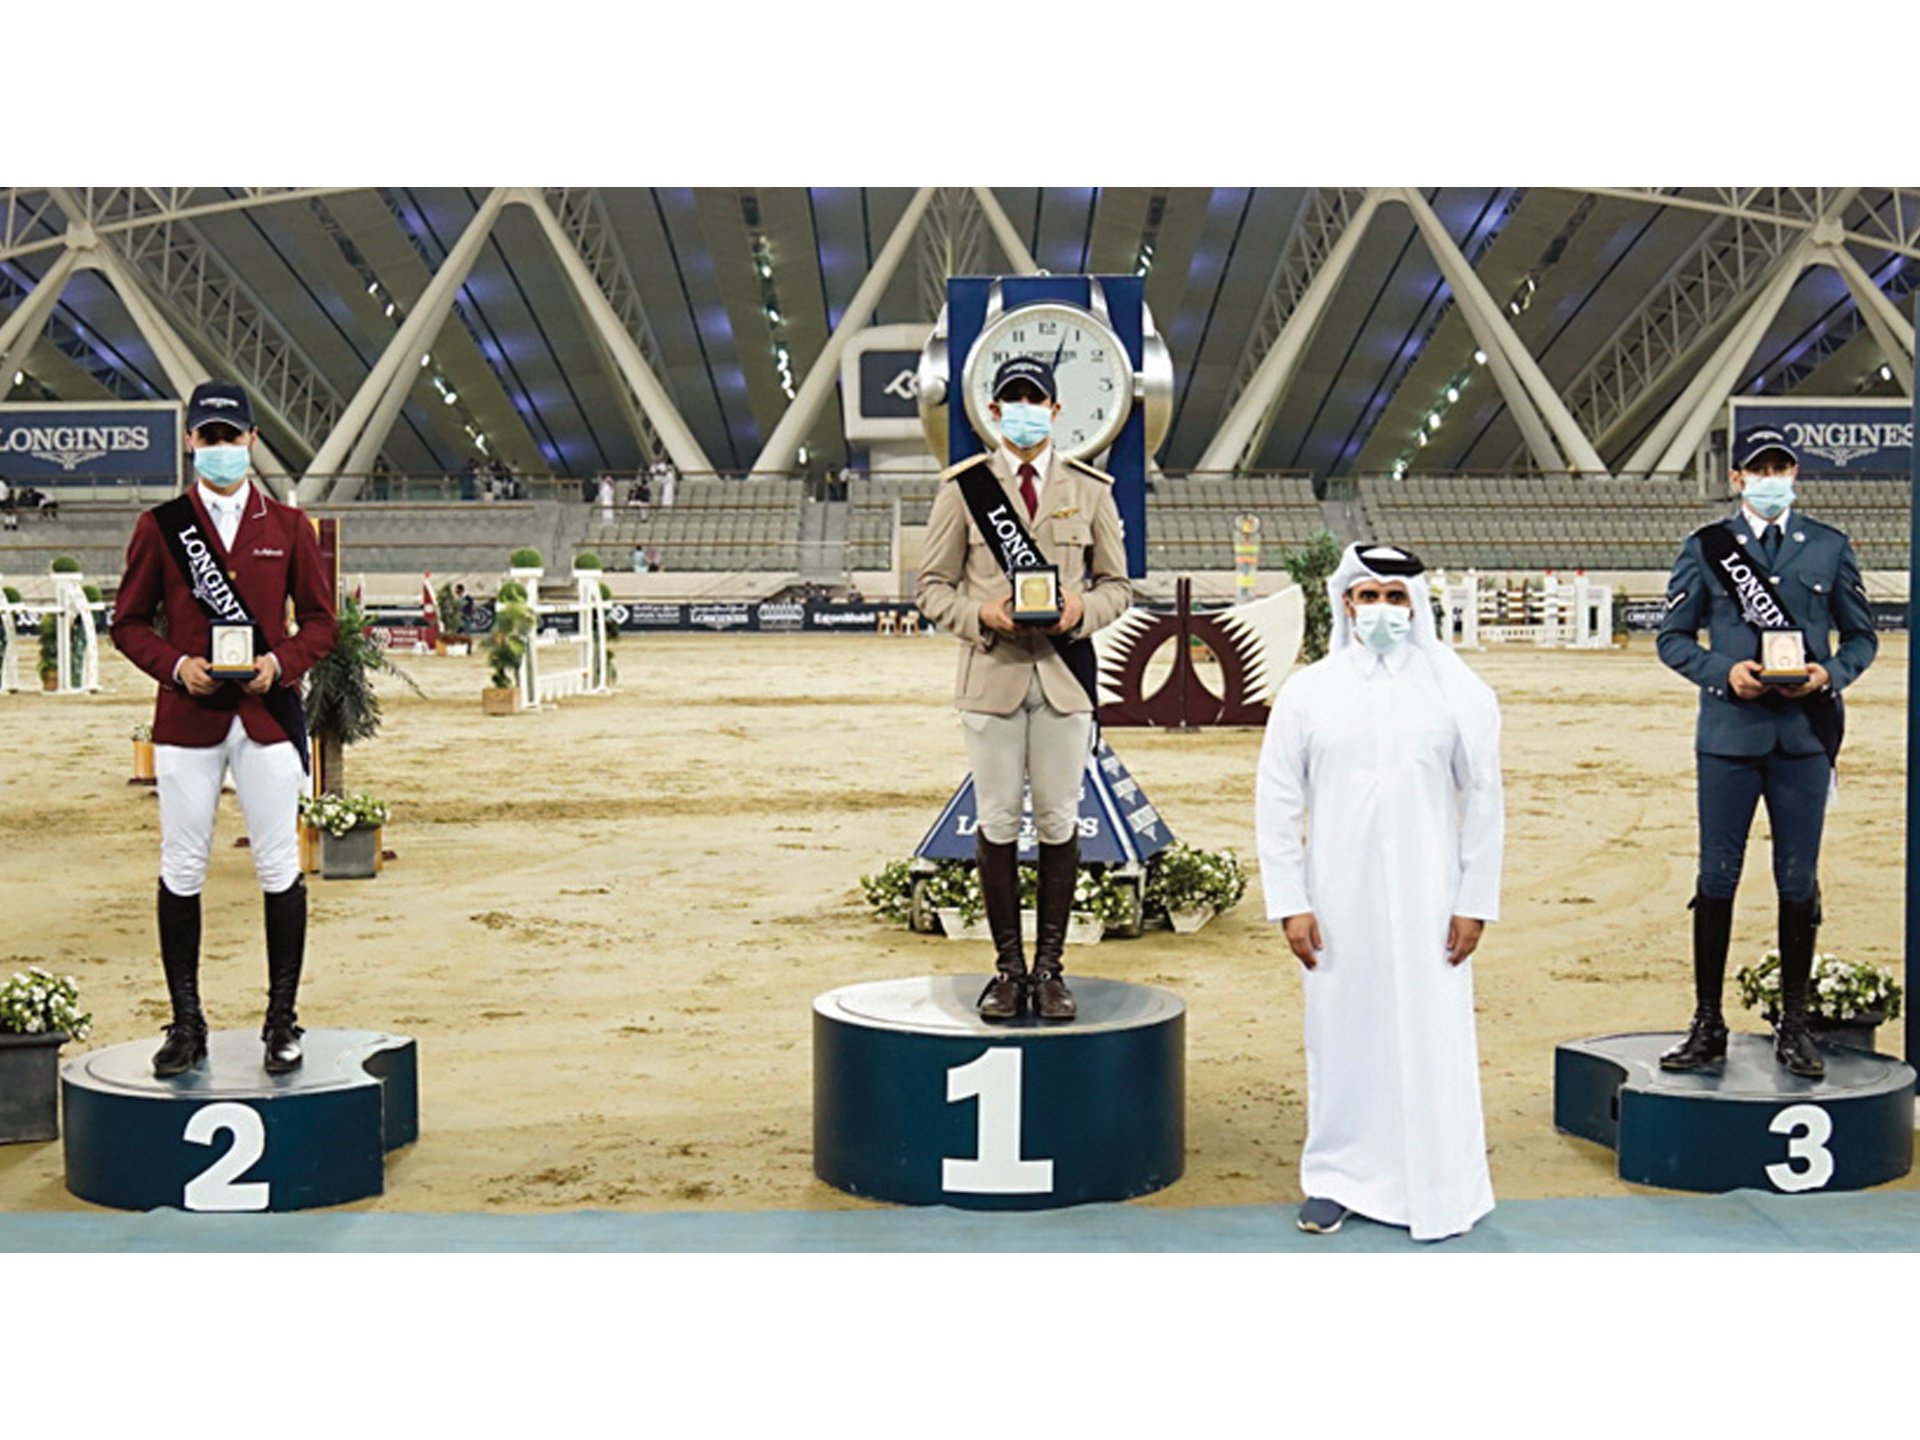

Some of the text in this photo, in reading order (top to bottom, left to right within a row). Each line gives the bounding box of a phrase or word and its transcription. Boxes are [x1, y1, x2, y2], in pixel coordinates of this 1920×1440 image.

[1783, 422, 1913, 447] ONGINES
[987, 504, 1040, 566] LONG
[1720, 552, 1789, 627] LONGIN
[183, 1103, 269, 1212] 2
[941, 1047, 1053, 1193] 1
[1765, 1104, 1834, 1193] 3
